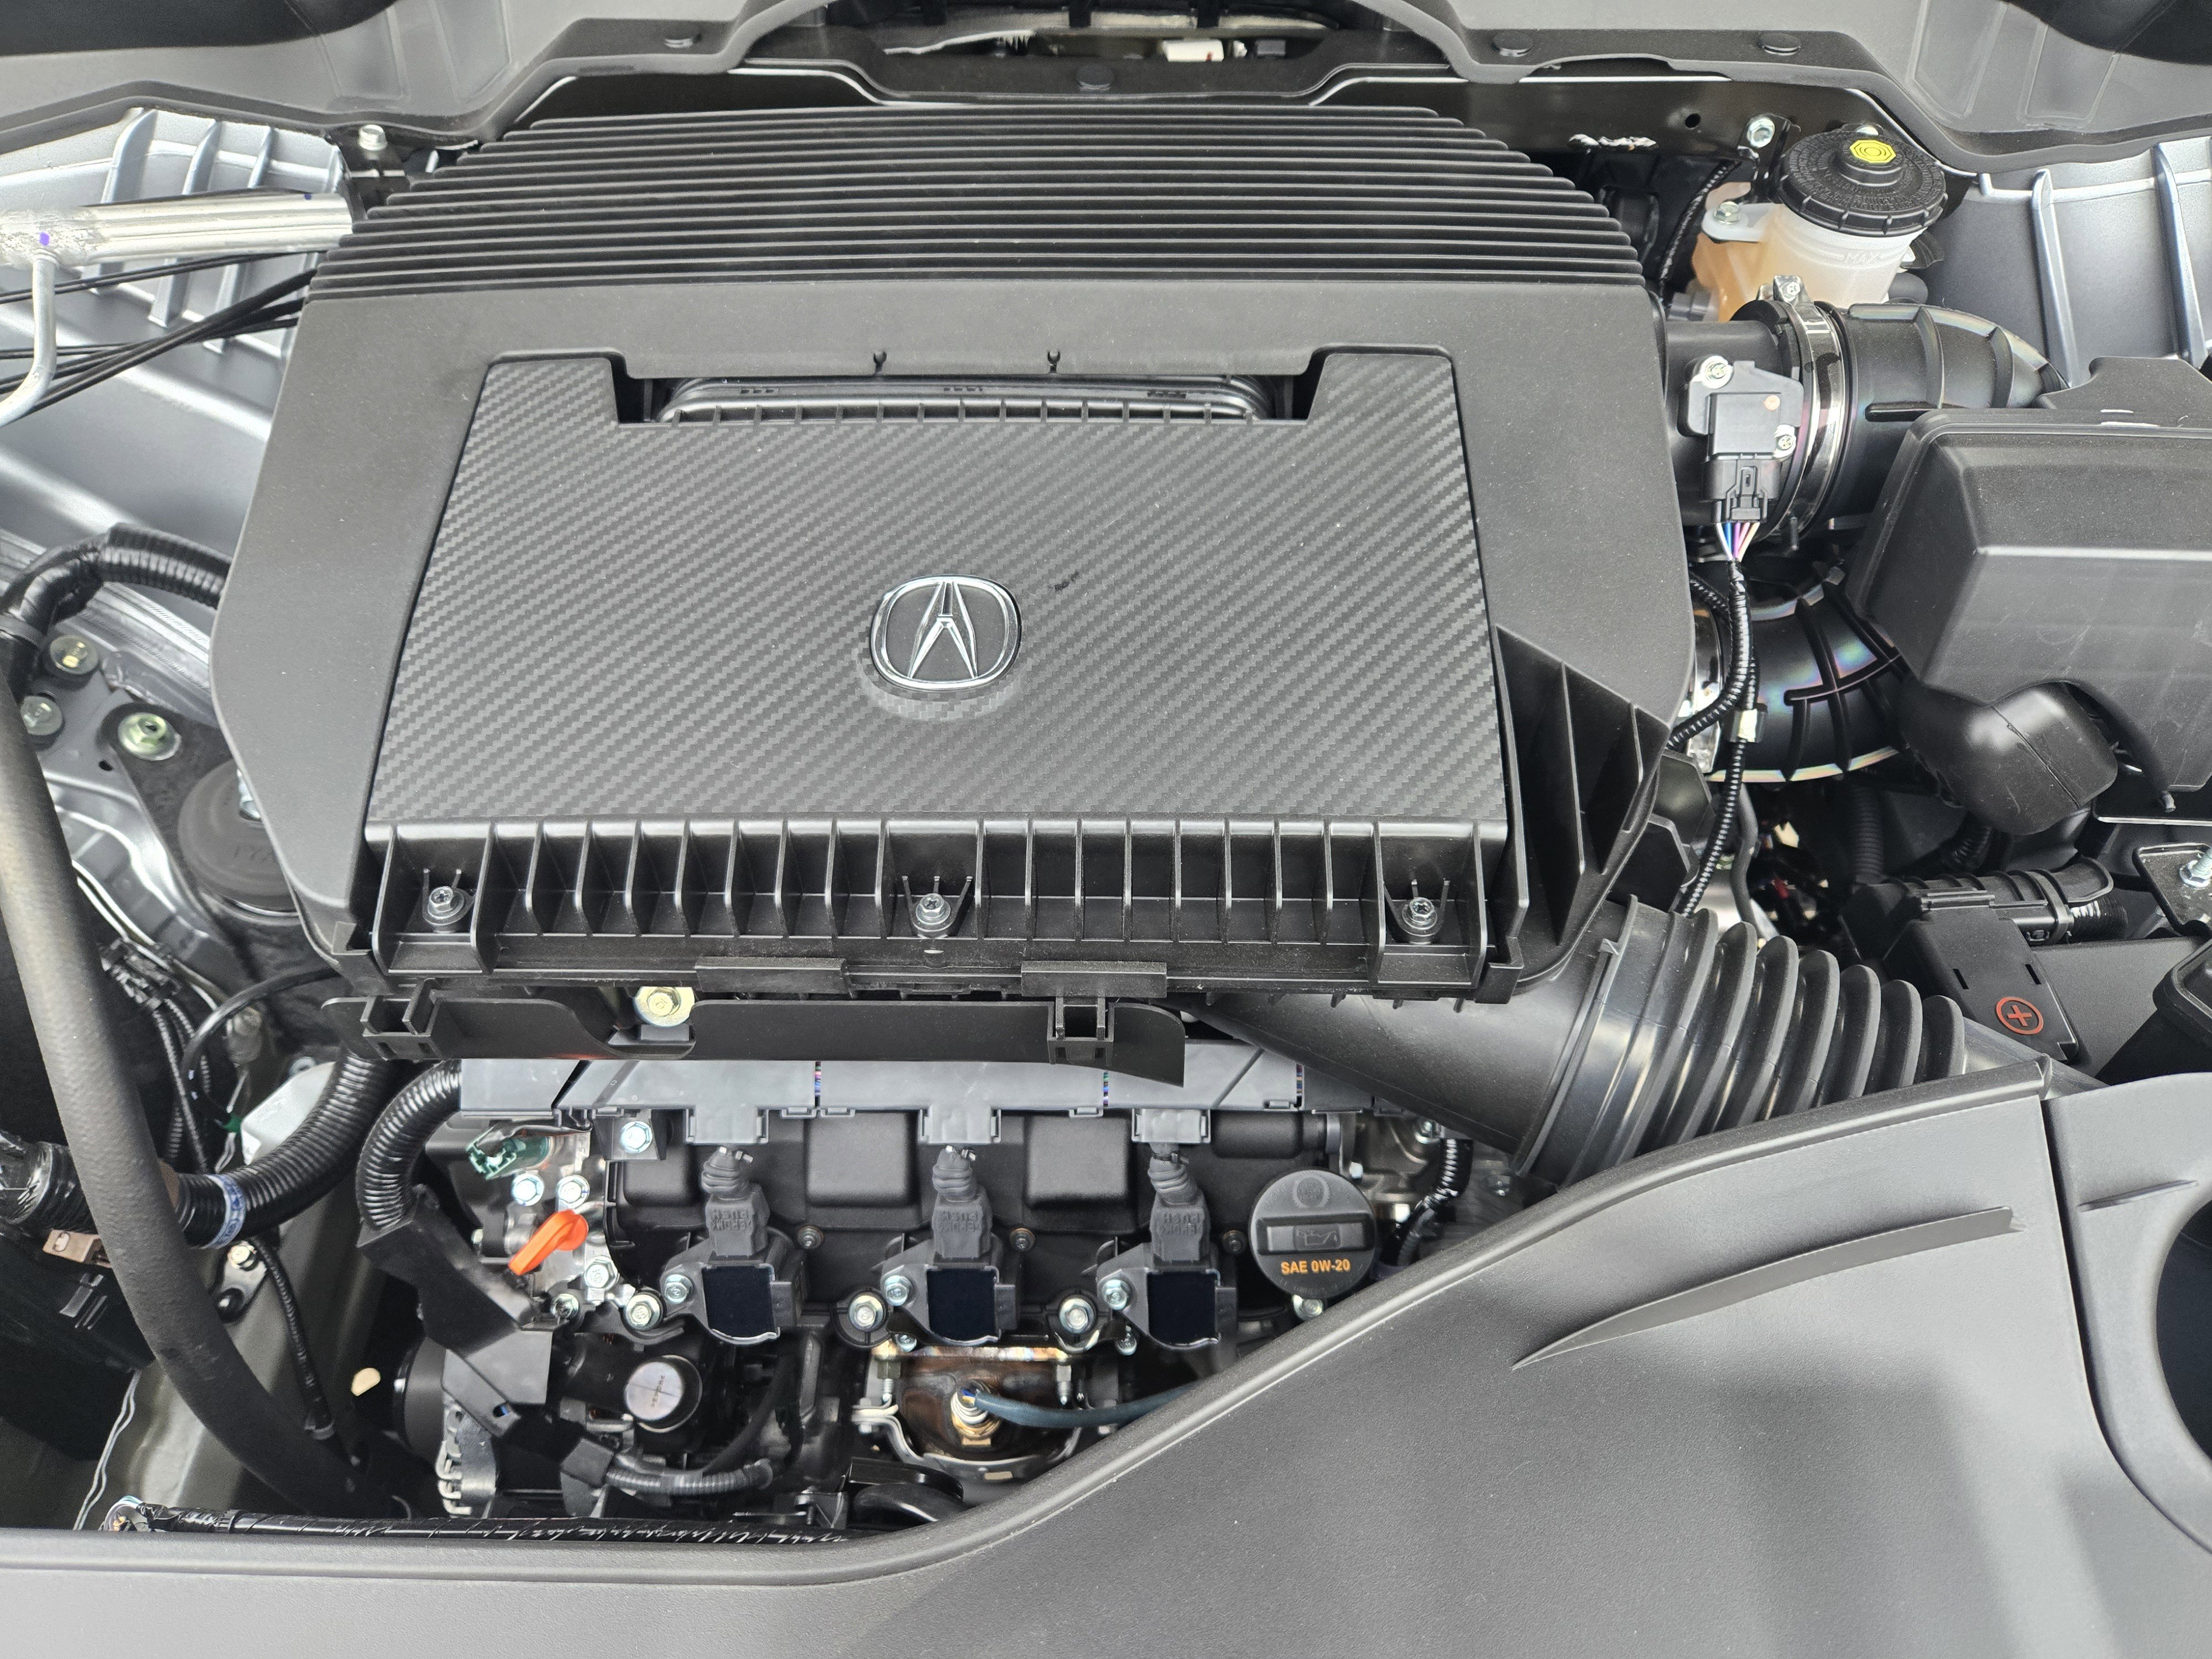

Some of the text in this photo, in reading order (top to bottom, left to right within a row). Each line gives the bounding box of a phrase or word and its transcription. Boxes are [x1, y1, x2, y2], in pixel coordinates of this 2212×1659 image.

[1844, 251, 1880, 265] MAX
[1263, 1183, 1287, 1211] ENGINE
[1338, 1185, 1353, 1199] OIL
[1281, 1259, 1351, 1275] SAE 0W-20
